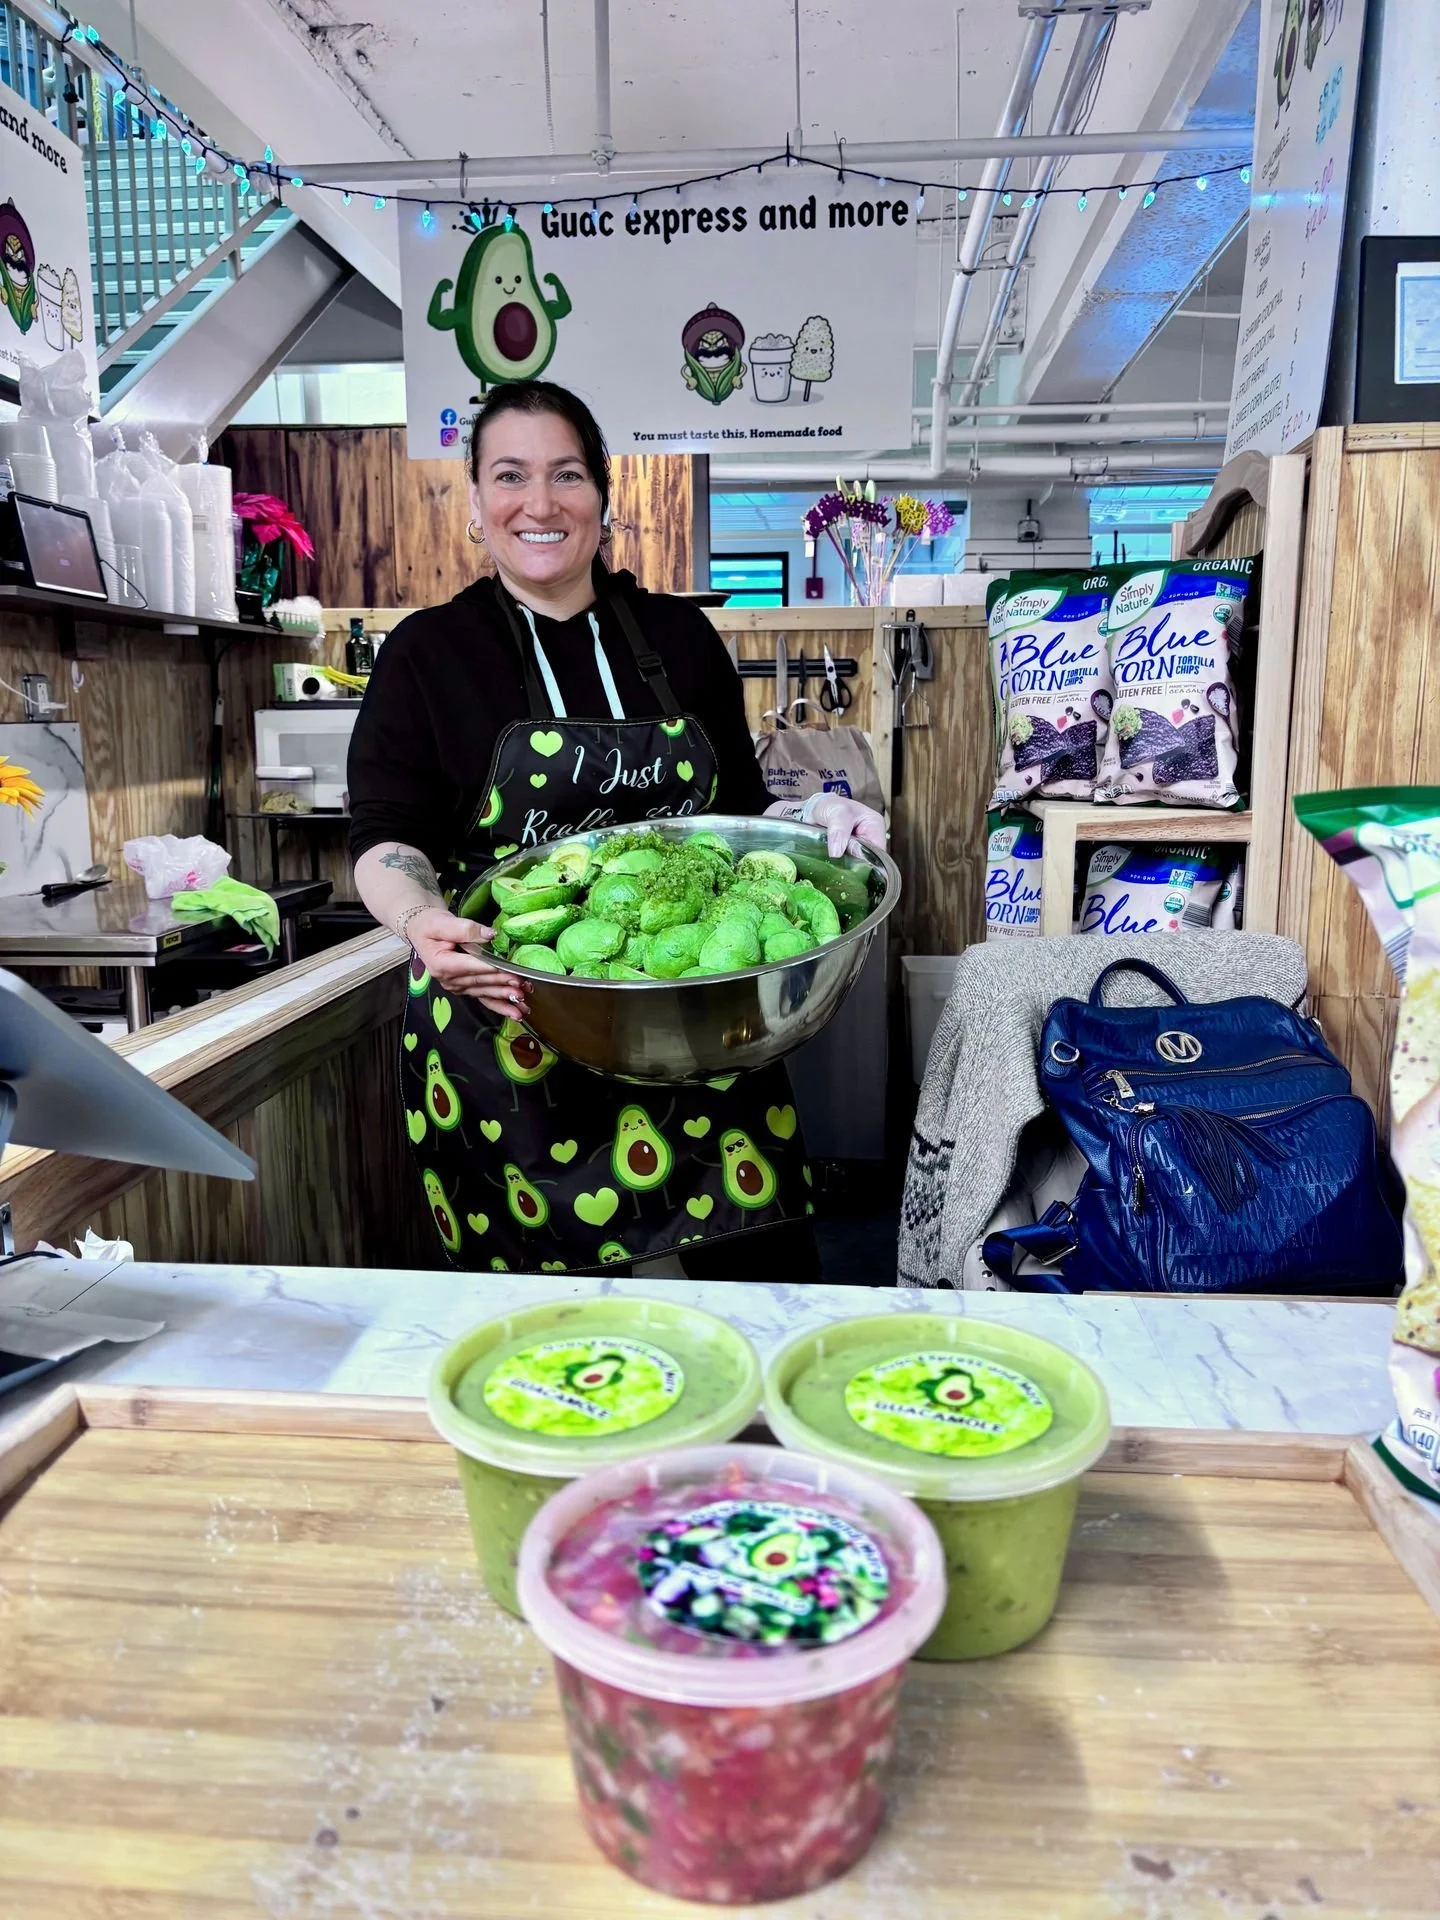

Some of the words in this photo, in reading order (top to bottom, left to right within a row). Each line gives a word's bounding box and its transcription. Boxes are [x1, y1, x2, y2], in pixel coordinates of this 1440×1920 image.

[31, 131, 68, 174] more
[541, 205, 614, 238] Guac
[625, 206, 748, 245] express
[759, 195, 816, 231] and
[828, 199, 908, 228] more
[632, 431, 655, 441] You
[657, 430, 688, 440] must
[690, 429, 720, 440] taste
[750, 426, 816, 438] Homemade
[817, 425, 843, 436] food
[1193, 559, 1254, 575] ORGANIC
[1120, 583, 1155, 603] Simply
[1012, 598, 1049, 609] Simply
[1115, 612, 1217, 663] Blue
[1011, 631, 1100, 672] Blue
[1113, 655, 1177, 686] CORN
[1175, 665, 1200, 675] CHIPS
[1177, 655, 1215, 669] TORTILLA
[1067, 667, 1099, 678] TORTILLA
[1031, 695, 1053, 706] FREE
[1115, 686, 1138, 700] LUTEN
[1140, 685, 1163, 696] FREE
[572, 745, 585, 785] I
[599, 747, 667, 795] Just
[817, 768, 834, 780] It's
[766, 777, 801, 788] plastic.
[521, 808, 618, 848] Reall
[1094, 853, 1122, 866] Simply
[1080, 893, 1164, 935] Blue
[873, 1401, 1004, 1433] GUACAMOLE
[1412, 1430, 1435, 1451] 140
